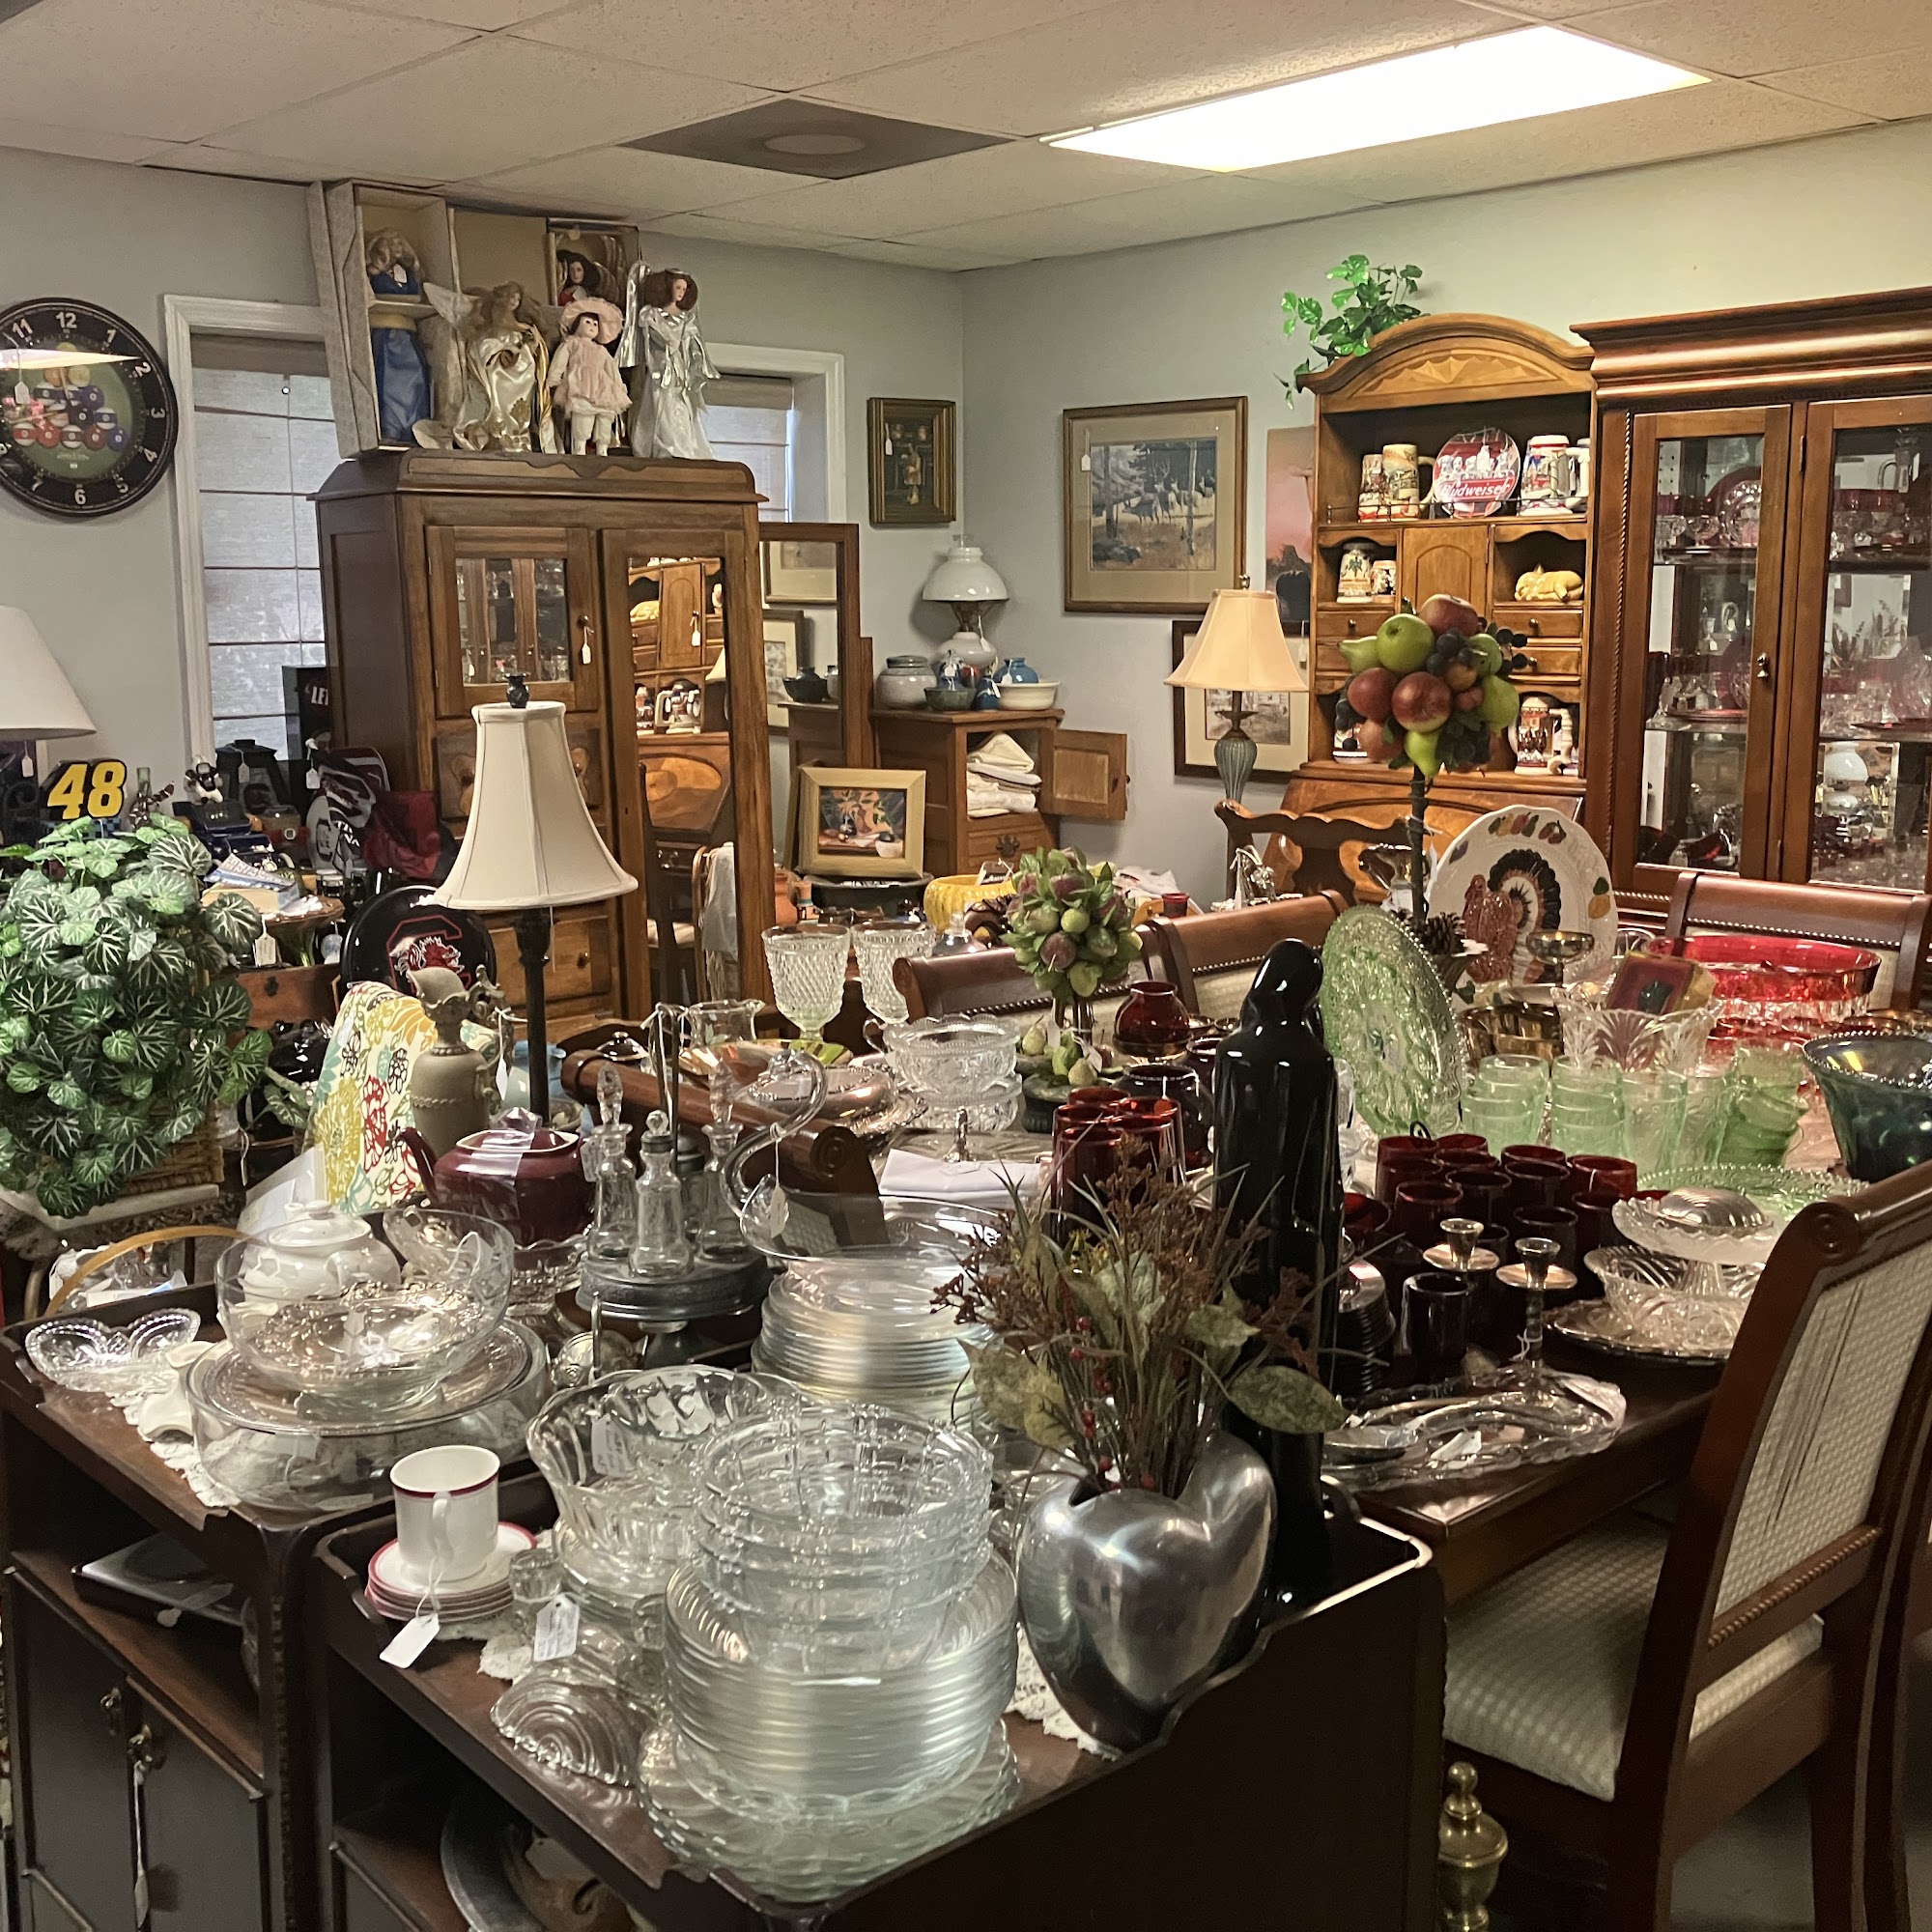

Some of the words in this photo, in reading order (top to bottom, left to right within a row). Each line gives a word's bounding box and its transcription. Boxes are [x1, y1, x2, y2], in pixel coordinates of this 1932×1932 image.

[56, 312, 76, 329] 12
[13, 319, 33, 338] 11
[107, 329, 117, 343] 1
[135, 362, 152, 377] 2
[151, 408, 165, 418] 3
[144, 448, 157, 462] 4
[117, 479, 128, 494] 5
[1439, 483, 1511, 497] Budweiser
[74, 489, 86, 504] 6
[46, 761, 127, 820] 48
